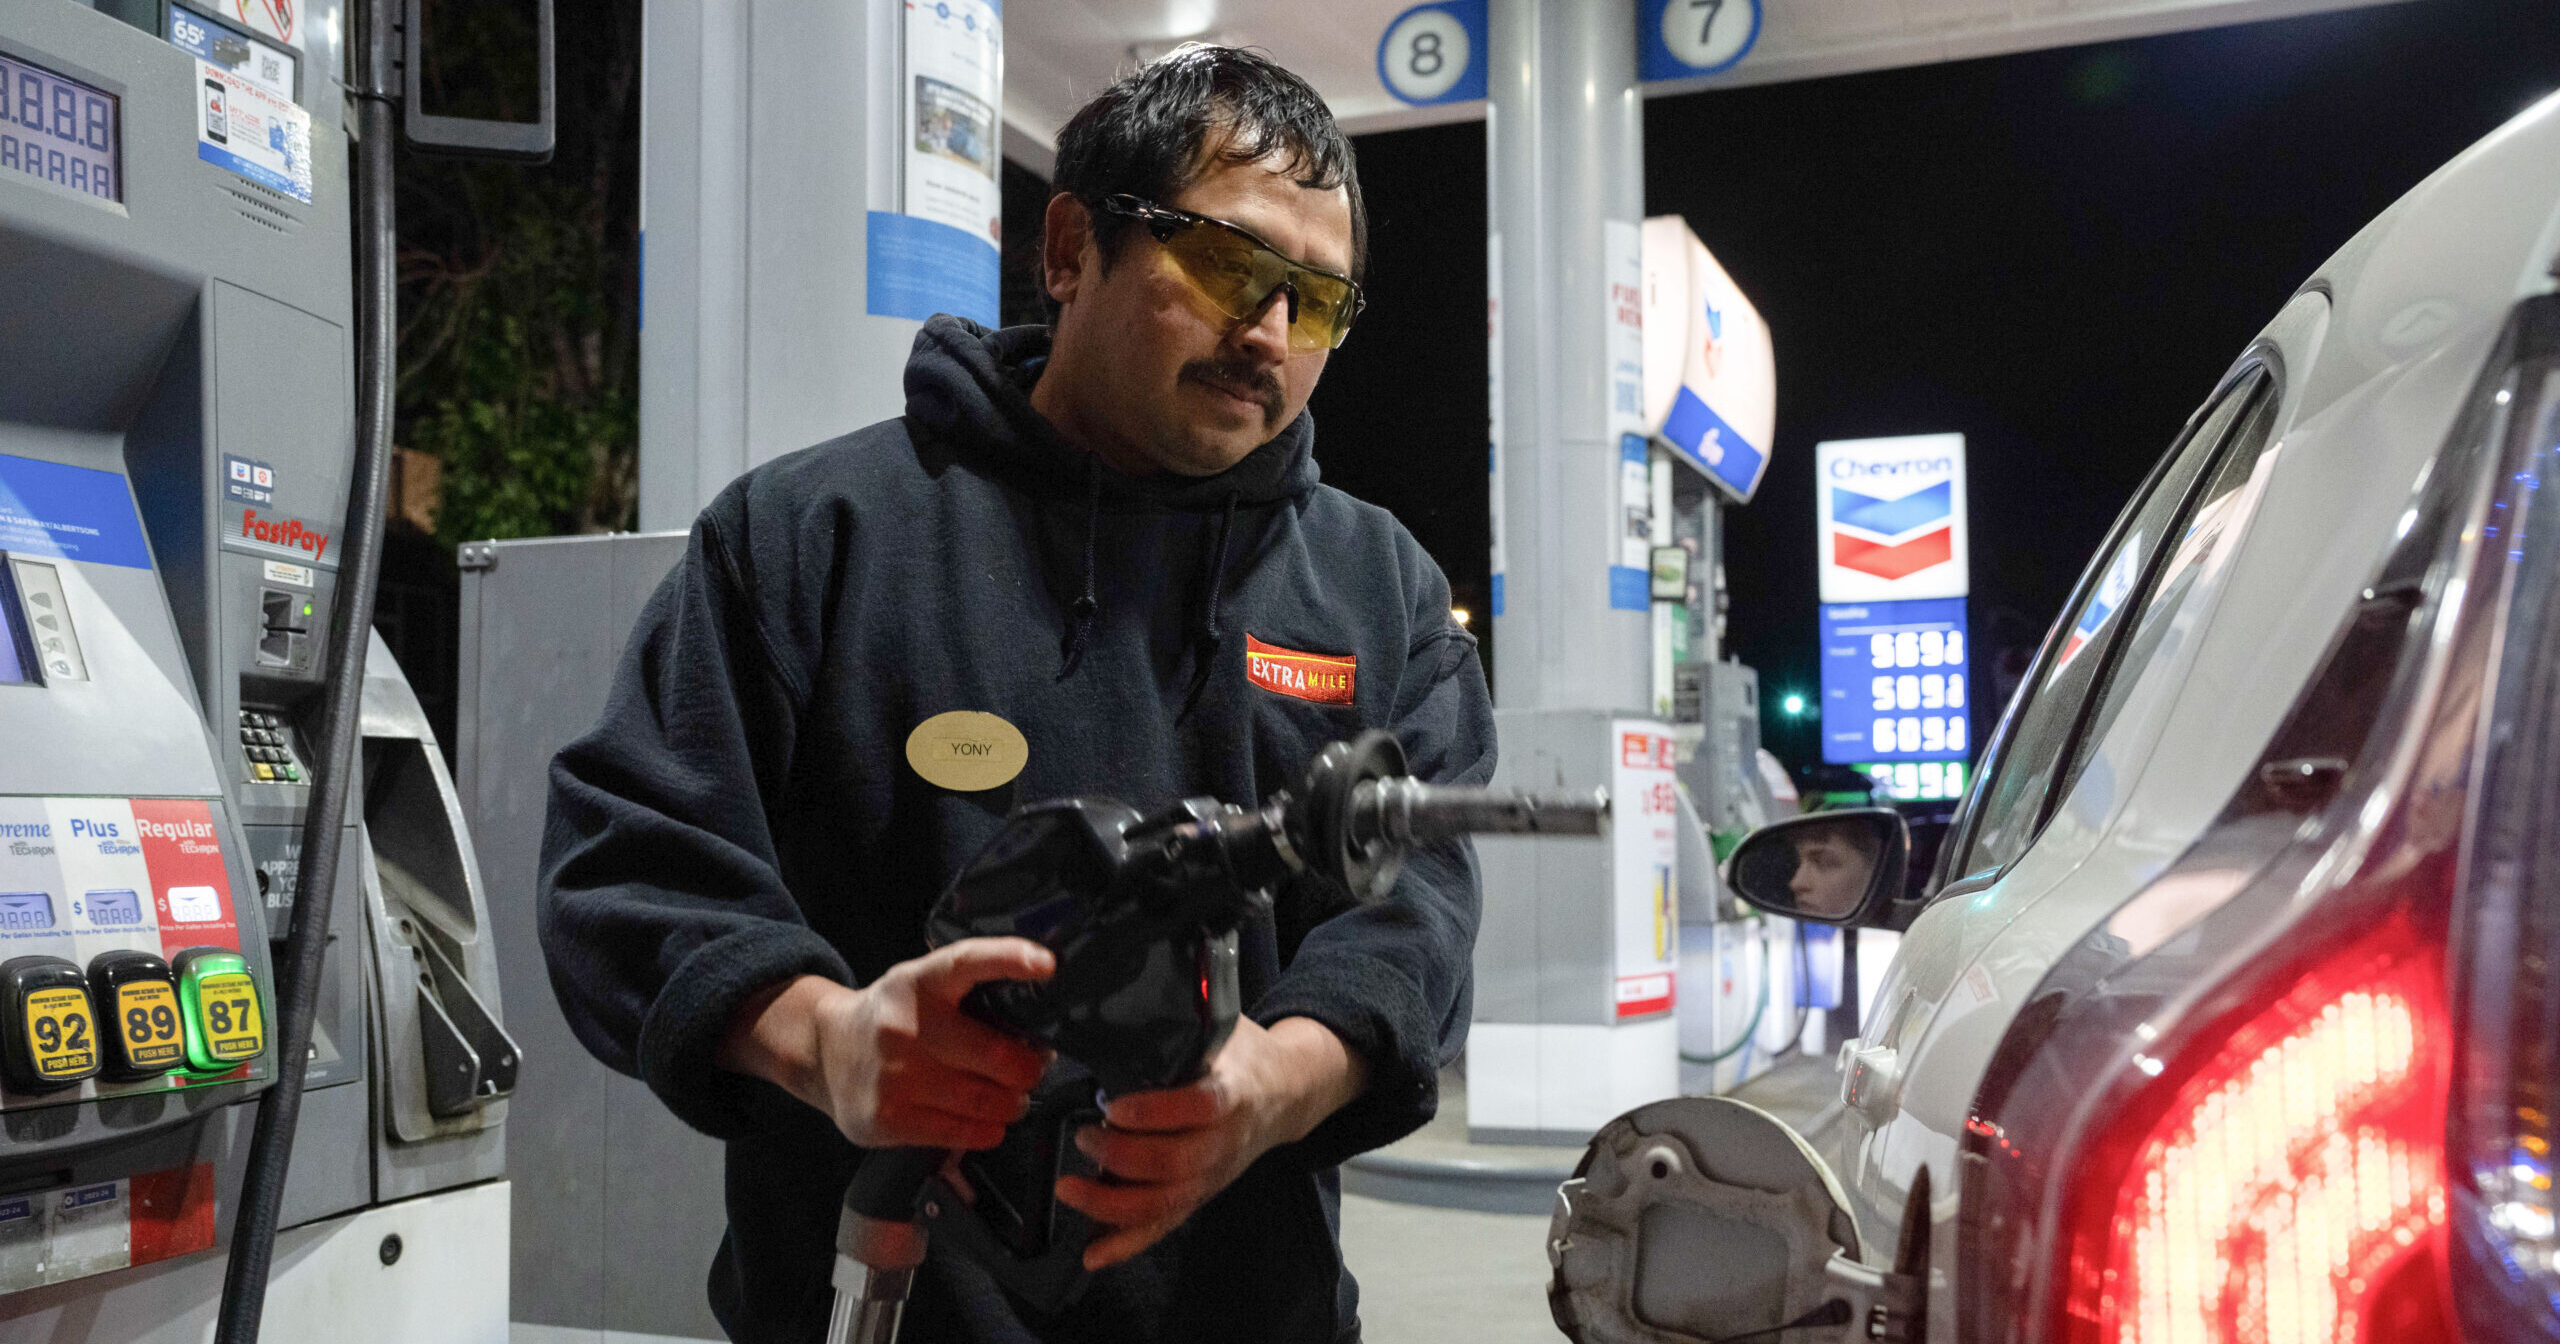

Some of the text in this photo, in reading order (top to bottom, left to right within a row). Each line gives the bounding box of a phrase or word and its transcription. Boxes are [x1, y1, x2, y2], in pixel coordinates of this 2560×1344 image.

[1687, 0, 1723, 45] 7
[1410, 32, 1443, 76] 8
[1830, 457, 1952, 479] Chevron
[242, 508, 329, 561] FastPay
[951, 743, 992, 756] YONY
[1870, 761, 1963, 799] 99
[70, 818, 119, 838] Plus
[136, 818, 213, 842] Regular
[9, 844, 56, 857] TECHRON
[97, 844, 141, 856] TECHRON
[73, 901, 83, 915] $
[158, 897, 168, 912] $
[127, 1004, 176, 1044] 89
[209, 998, 250, 1035] 87
[35, 1012, 90, 1053] 92
[138, 1046, 175, 1059] PUSH HERE
[220, 1040, 254, 1051] PUSH HERE
[47, 1055, 88, 1070] PUSH HERE
